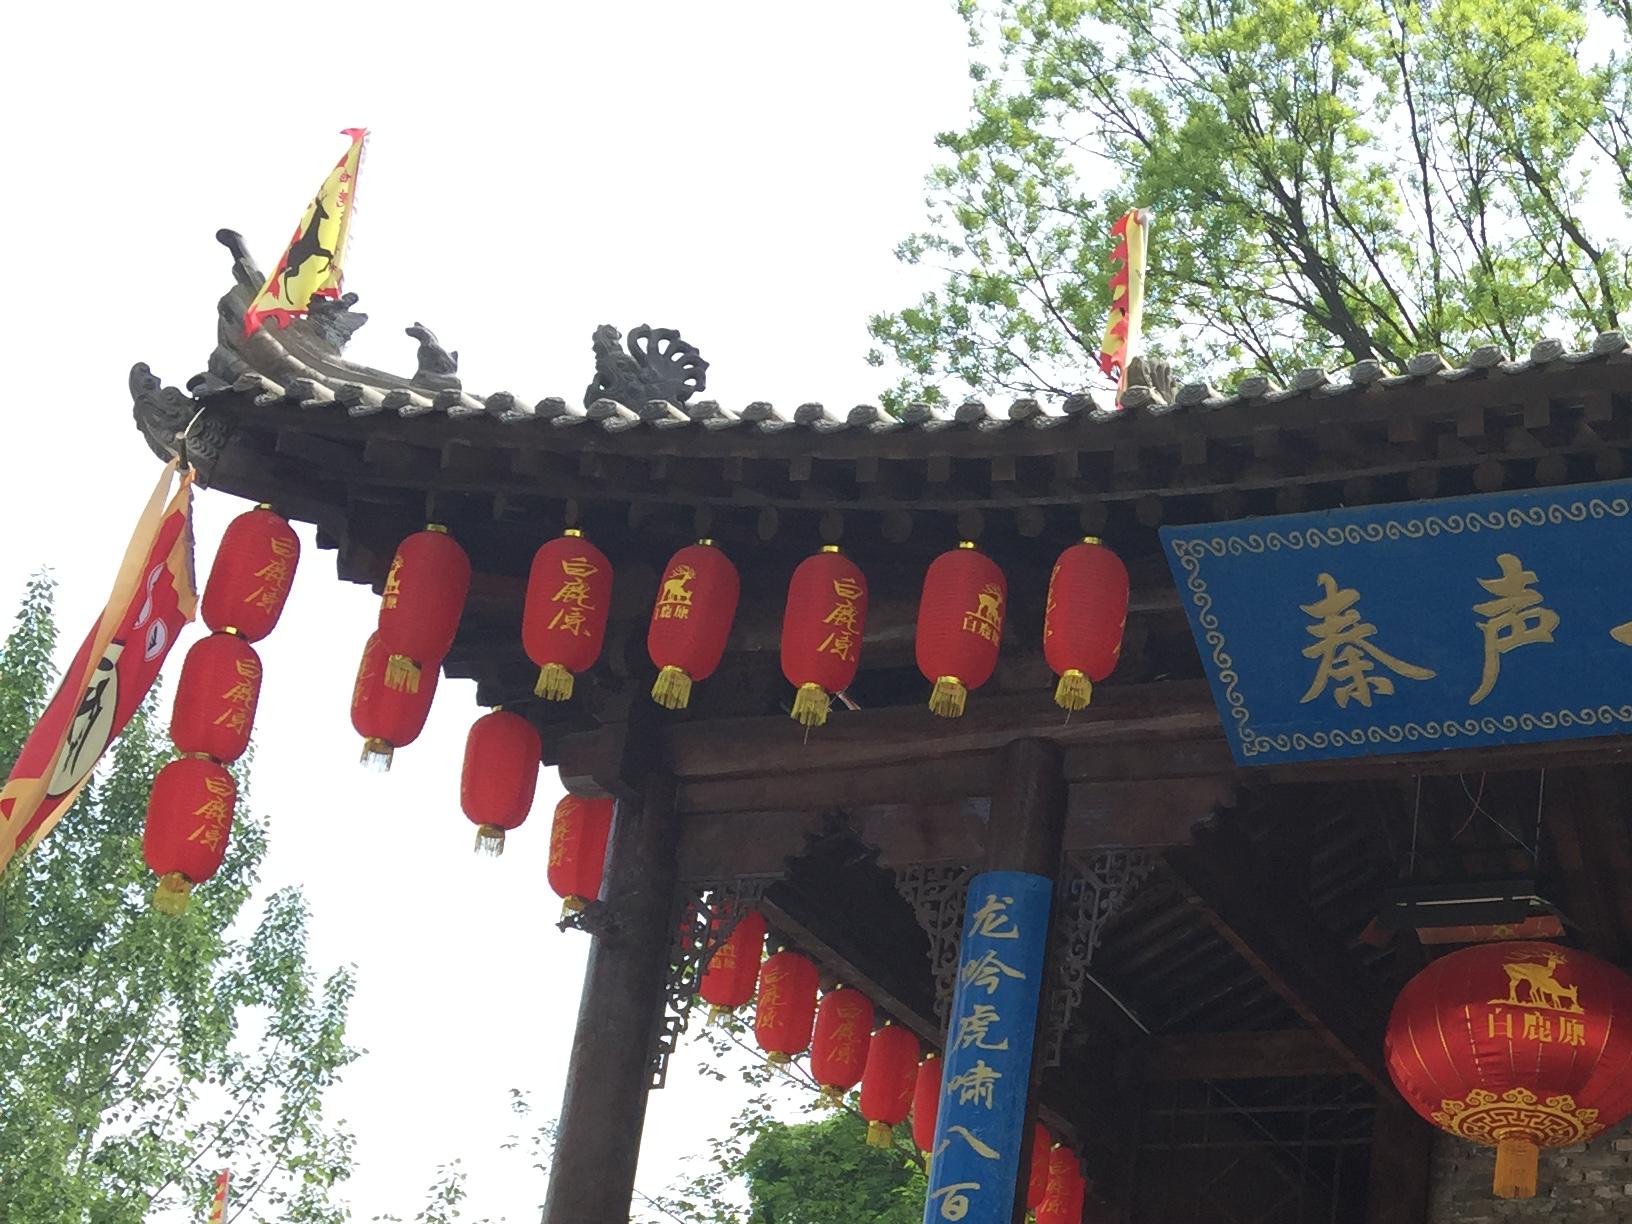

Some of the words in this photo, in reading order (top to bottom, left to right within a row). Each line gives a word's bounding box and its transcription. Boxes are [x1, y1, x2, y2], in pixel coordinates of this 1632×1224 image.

[548, 557, 599, 638] 白鹿原
[1487, 1012, 1587, 1046] 白鹿原
